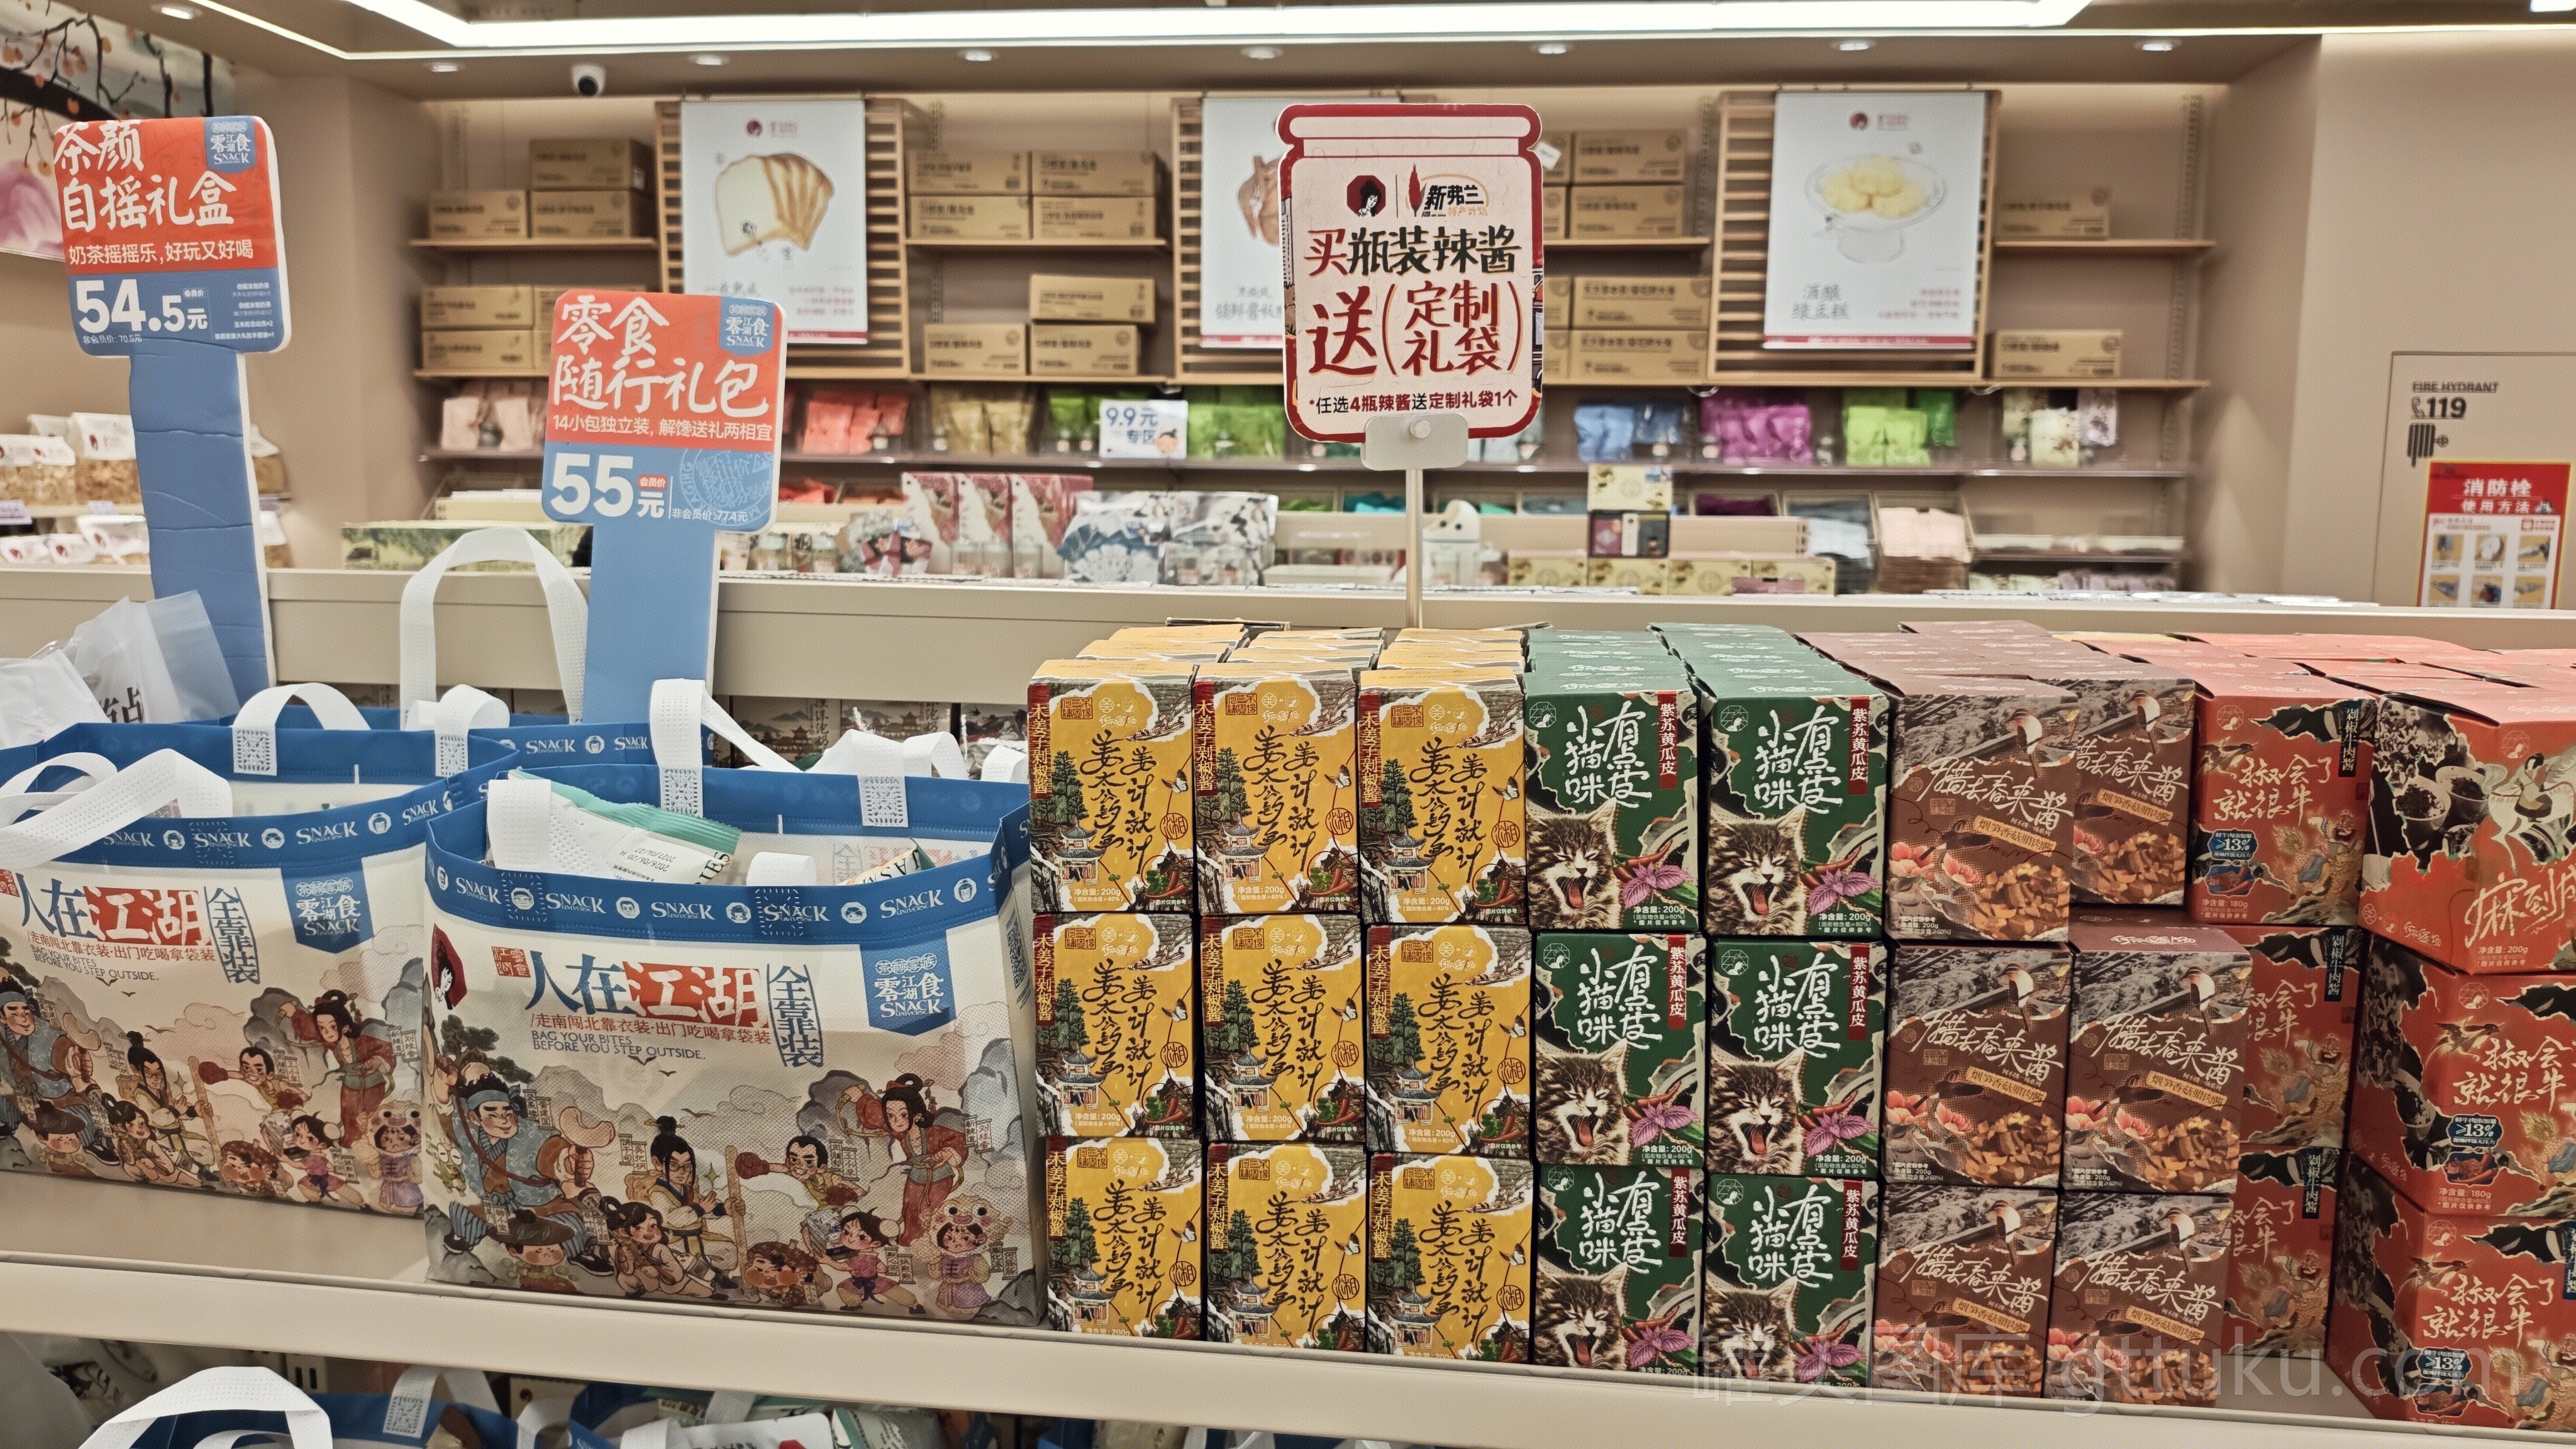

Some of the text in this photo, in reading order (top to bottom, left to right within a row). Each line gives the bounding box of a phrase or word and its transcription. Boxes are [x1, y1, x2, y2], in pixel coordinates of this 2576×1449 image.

[53, 120, 144, 175] 茶颜
[214, 153, 250, 164] SNACK
[64, 170, 237, 233] 自摇礼盒
[1424, 185, 1484, 210] 新弗兰
[69, 240, 253, 265] 奶茶摇摇乐，好玩又好喝
[1304, 225, 1522, 277] 买瓶装辣酱
[557, 295, 670, 356] 零食
[727, 335, 765, 348] SNACK
[1306, 286, 1378, 377] 送
[553, 354, 769, 418] 随行礼包
[2412, 381, 2499, 393] FIRE HYDRANT
[2427, 396, 2467, 419] 119
[553, 414, 773, 441] 14小包独立装，解馋送礼两相宜
[1106, 407, 1158, 426] 9.9元
[640, 478, 666, 487] 会员价
[2462, 501, 2530, 514] 使用方法
[2463, 478, 2532, 497] 消防栓
[526, 739, 576, 754] SNACK
[614, 736, 648, 752] SNACK
[1031, 704, 1050, 794] 木姜子剁椒酱
[1196, 701, 1215, 791] 木姜子剁椒酱
[1360, 713, 1381, 802] 木姜子剁椒酱
[1564, 706, 1609, 804] 小猫咪
[1597, 701, 1652, 808] 有点皮
[1659, 703, 1677, 776] 紫苏黄瓜皮
[1753, 709, 1802, 809] 小猫咪
[1786, 704, 1845, 813] 有点皮
[1850, 708, 1870, 782] 紫苏黄瓜皮
[2342, 708, 2358, 772] 剁椒牛肉酱
[296, 821, 358, 845] SNACK
[402, 800, 439, 826] SNACK
[2213, 784, 2313, 827] 就很牛
[104, 831, 155, 847] SNACK
[195, 832, 252, 848] SNACK
[457, 877, 502, 904] SNACK
[695, 852, 730, 884] IES
[16, 873, 212, 946] 人在江湖
[304, 918, 360, 936] SNACK
[546, 893, 606, 914] SNACK
[651, 902, 715, 920] SNACK
[763, 904, 830, 922] SNACK
[881, 889, 945, 919] SNACK
[31, 944, 96, 967] BAG YOUR BITES
[34, 953, 159, 980] BEFORE YOU STEP OUTSIDE.
[875, 953, 937, 975] 茶颜家族
[1035, 934, 1055, 1020] 木姜子剁椒酱
[1204, 935, 1223, 1021] 木姜子剁椒酱
[1670, 948, 1688, 1019] 紫苏黄瓜皮
[2328, 935, 2344, 996] 剁椒牛肉酱
[525, 950, 769, 1028] 人在江湖
[880, 998, 941, 1017] SNACK
[1369, 947, 1391, 1034] 木姜子剁椒酱
[1576, 948, 1621, 1045] 小猫咪
[1609, 943, 1663, 1049] 有点皮
[1752, 954, 1802, 1053] 小猫咪
[1785, 950, 1845, 1058] 有点皮
[1848, 956, 1870, 1028] 紫苏黄瓜皮
[532, 1030, 632, 1045] BAG YOUR BITES
[533, 1040, 706, 1060] BEFORE YOU STEP OUTSIDE.
[2482, 1035, 2575, 1072] 椒会
[2453, 1067, 2567, 1113] 就很牛
[1047, 1152, 1067, 1236] 木姜子剁椒酱
[1208, 1163, 1229, 1250] 木姜子剁椒酱
[1670, 1176, 1690, 1246] 紫苏黄瓜皮
[2304, 1155, 2321, 1214] 剁椒牛肉酱
[1370, 1172, 1394, 1258] 木姜子剁椒酱
[1577, 1171, 1625, 1268] 小猫咪
[1609, 1169, 1666, 1274] 有点皮
[1746, 1185, 1796, 1282] 小猫咪
[1779, 1182, 1838, 1288] 有点皮
[1841, 1189, 1863, 1260] 紫苏黄瓜皮
[2423, 1301, 2534, 1350] 就很牛
